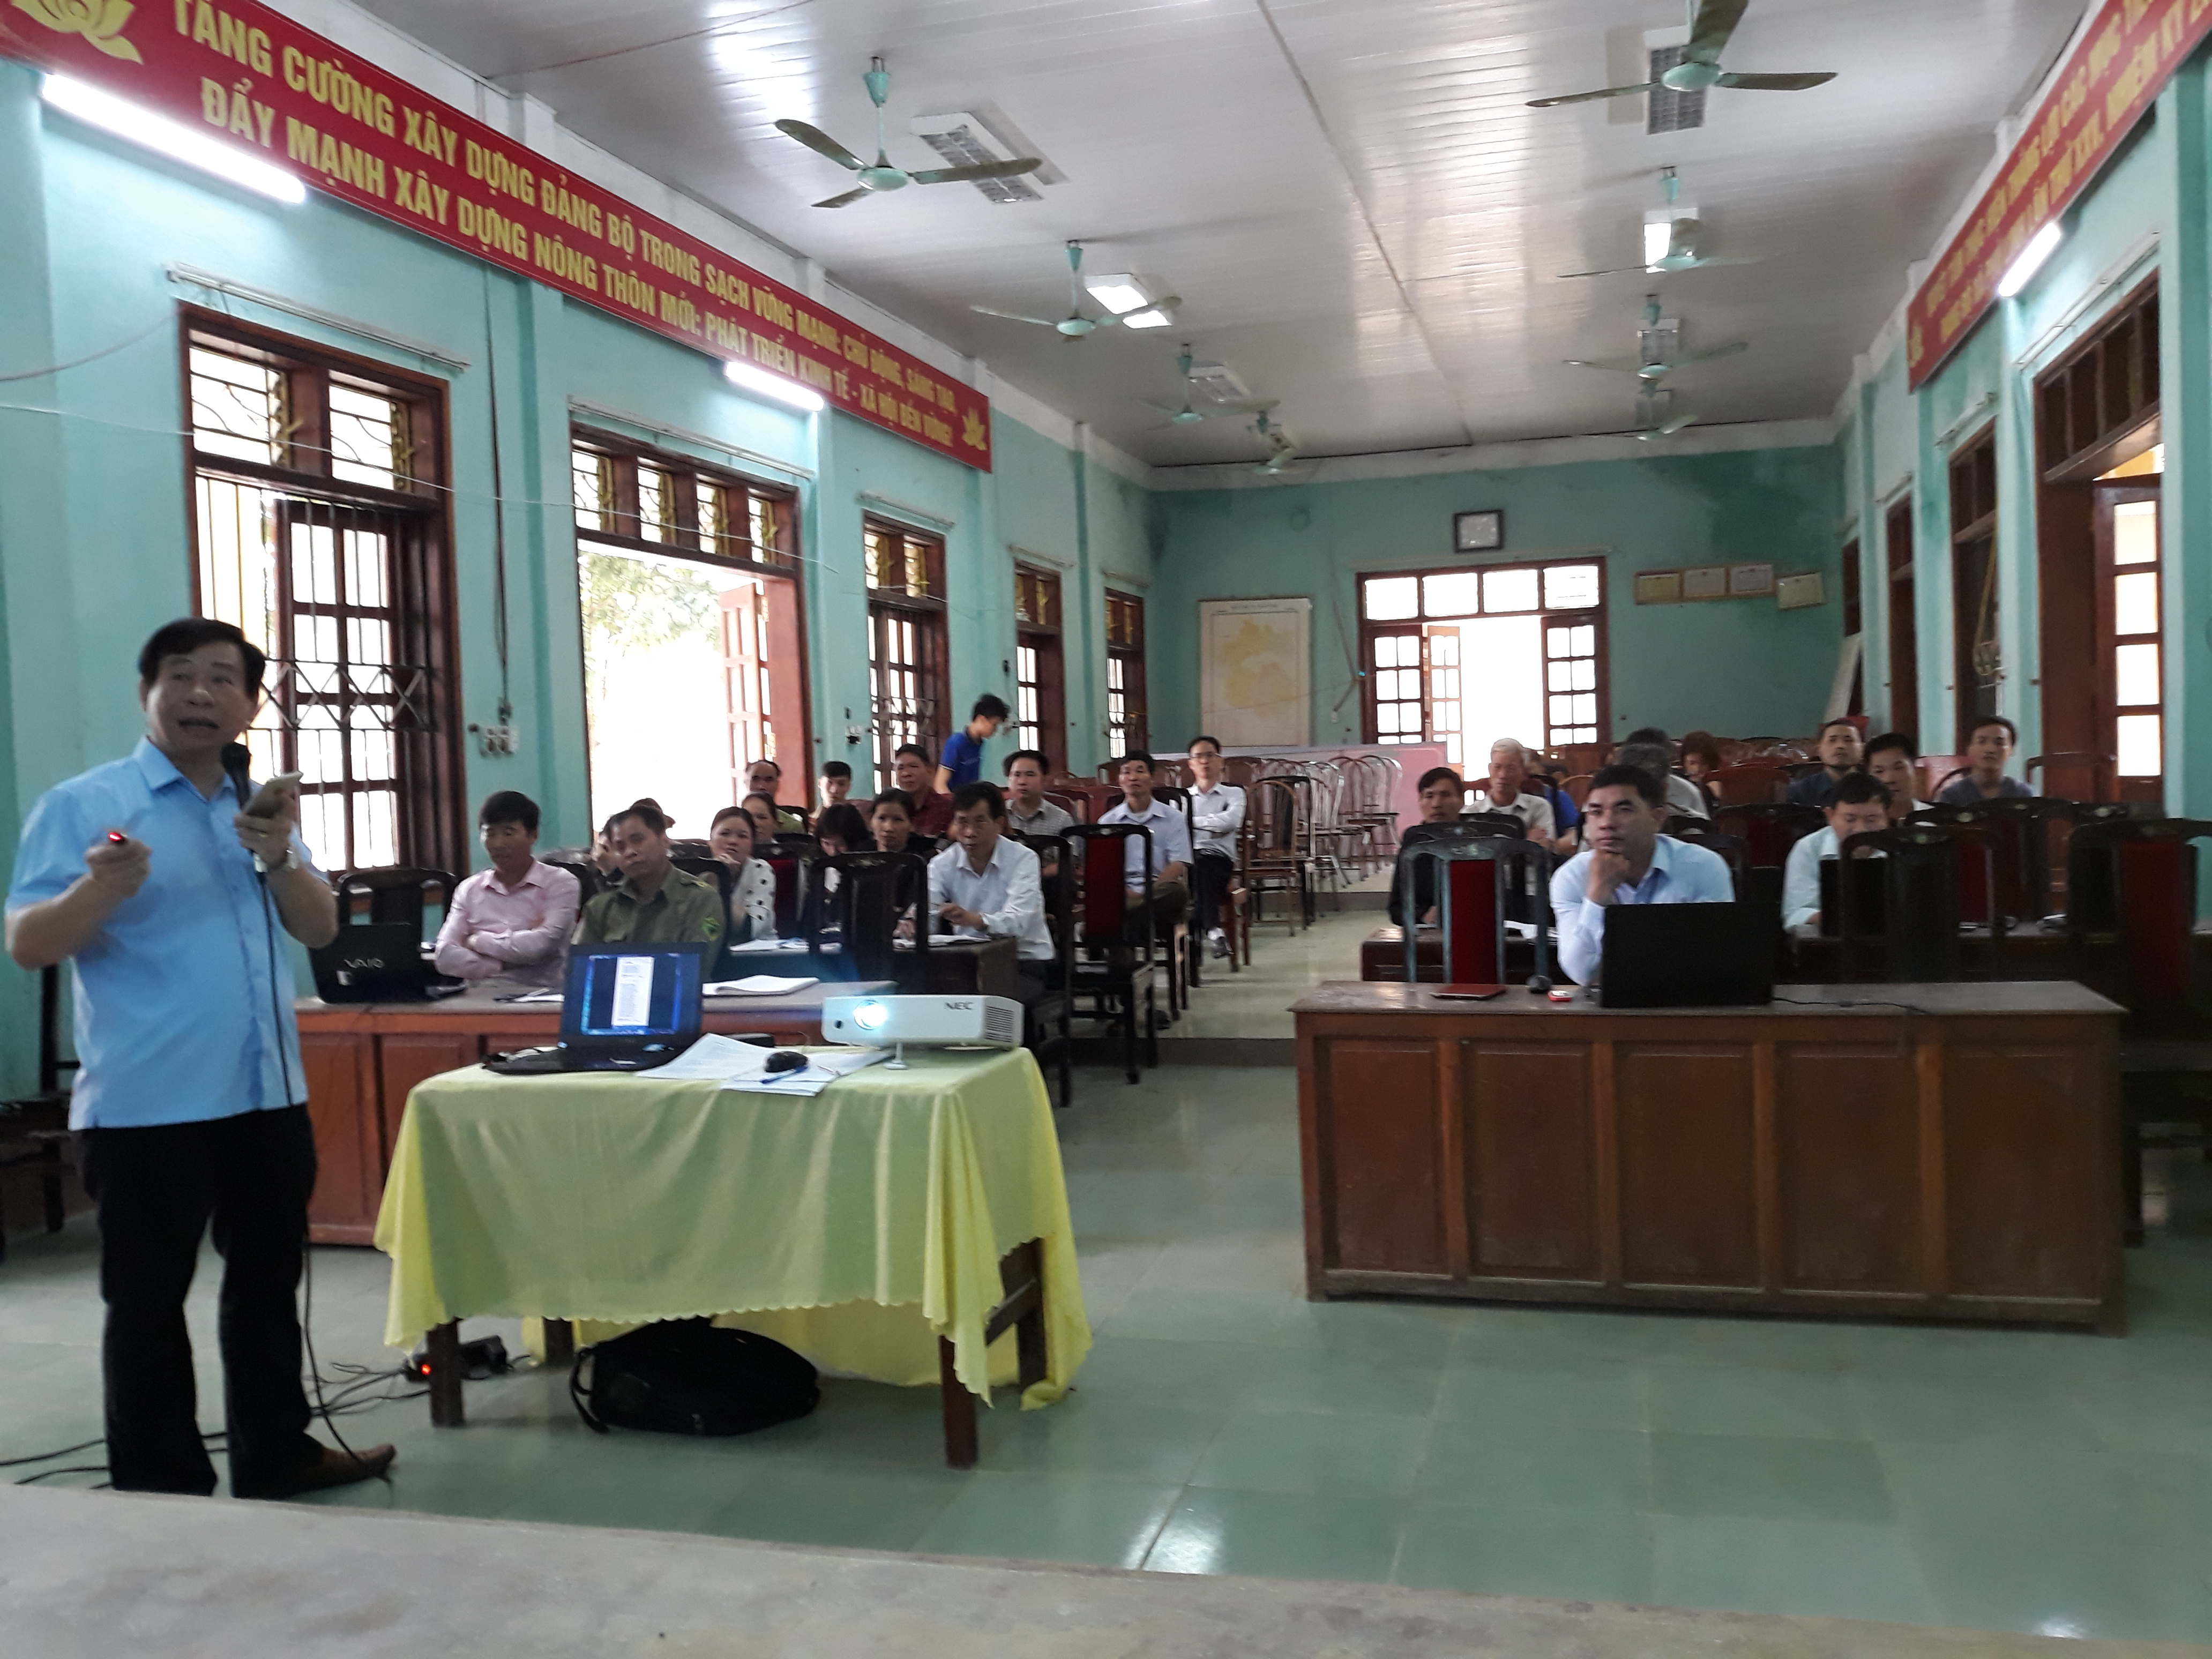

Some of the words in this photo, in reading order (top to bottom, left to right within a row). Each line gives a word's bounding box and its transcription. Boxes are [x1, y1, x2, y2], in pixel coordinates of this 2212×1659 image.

[200, 76, 275, 148] ĐẨY
[286, 116, 386, 199] MẠNH
[393, 166, 449, 225] XÂY
[457, 196, 529, 261] DỰNG
[533, 231, 598, 291] NÔNG
[602, 263, 655, 317] THÔN
[705, 311, 748, 356] PHÁT
[750, 332, 796, 377] TRIỂN
[282, 45, 395, 138] CƯỜNG
[402, 104, 458, 167] XÂY
[465, 138, 535, 207] DỰNG
[540, 173, 602, 240] ĐẢNG
[606, 211, 636, 261] BỘ
[639, 229, 702, 287] TRONG
[704, 263, 750, 310] SẠCH
